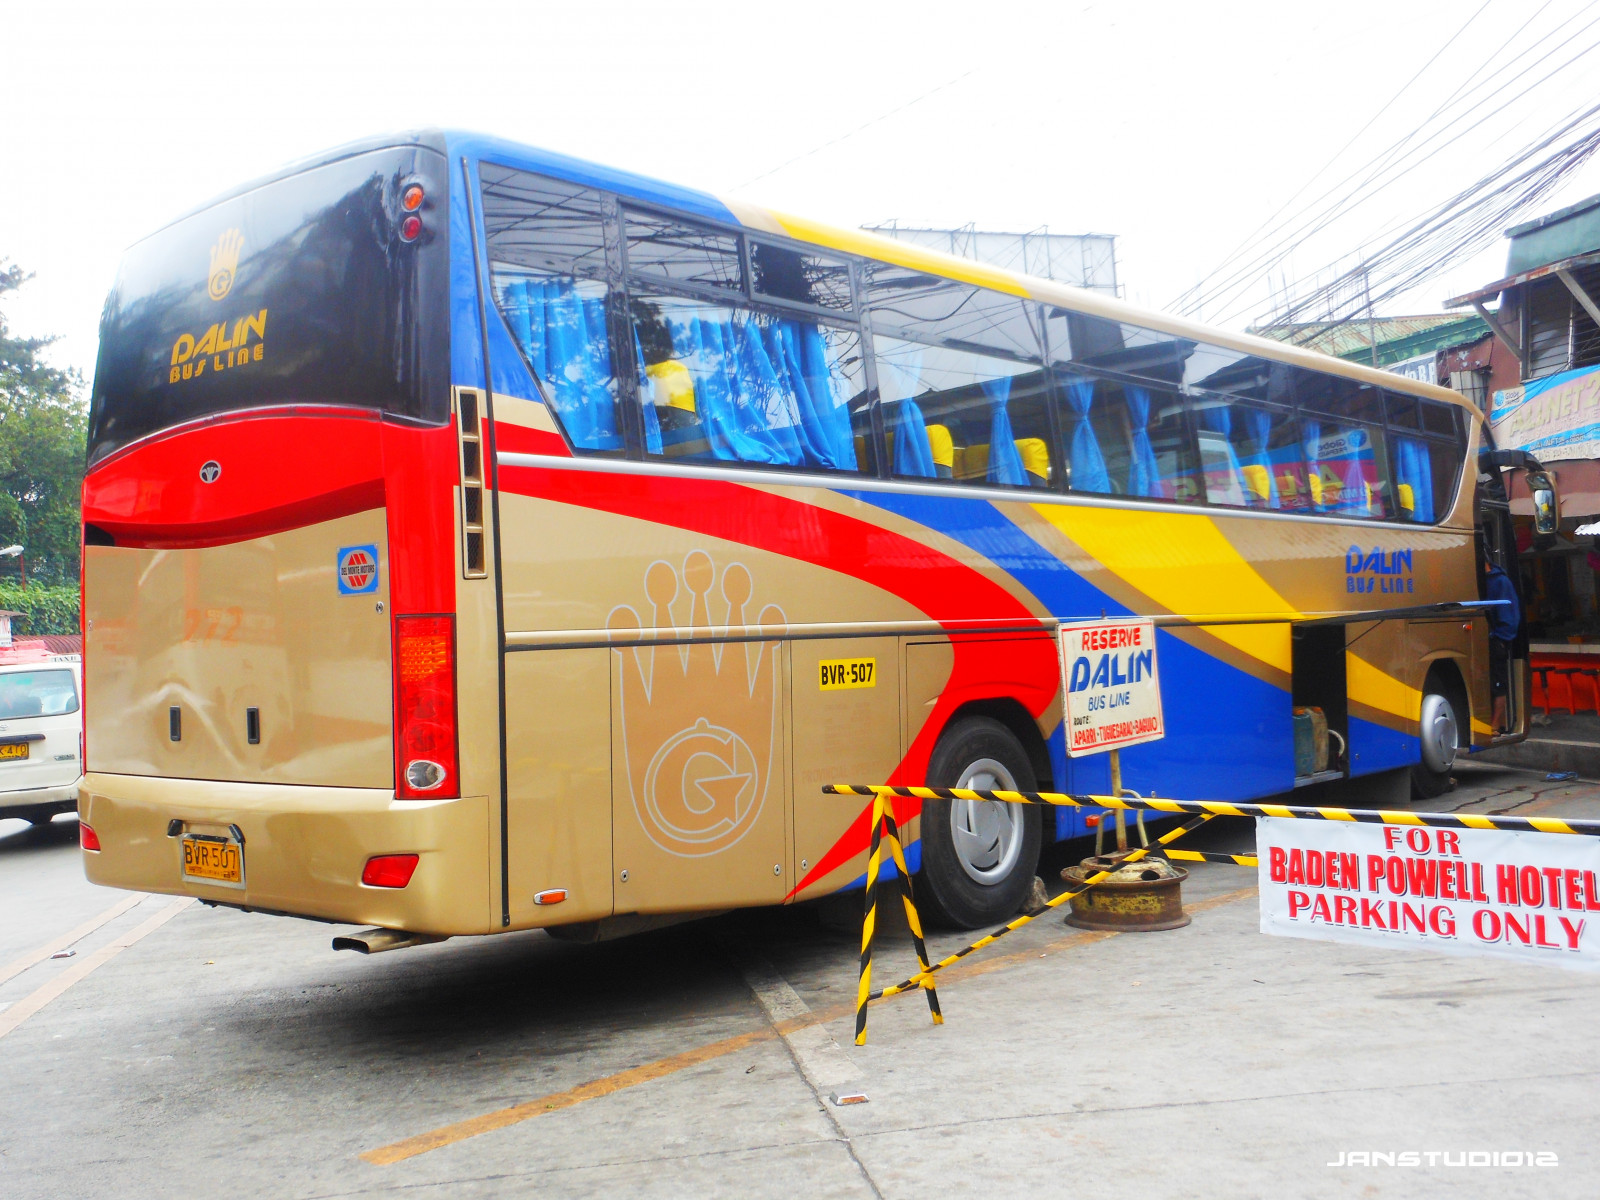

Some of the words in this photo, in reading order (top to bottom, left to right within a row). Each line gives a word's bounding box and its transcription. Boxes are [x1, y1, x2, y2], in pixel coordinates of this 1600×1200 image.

[171, 309, 268, 365] DALIN
[169, 359, 207, 384] BUS
[214, 343, 264, 371] LINE
[1345, 545, 1412, 574] DALIN
[1346, 576, 1375, 593] BUS
[1380, 577, 1414, 593] LINE
[1081, 627, 1141, 651] RESERVE
[1068, 649, 1153, 693] DALIN
[1088, 695, 1106, 711] BUS
[1109, 691, 1130, 708] LINE
[1383, 826, 1462, 857] FOR
[1269, 846, 1360, 892] BADEN
[1367, 854, 1489, 904] POWELL
[1496, 863, 1600, 913] HOTEL
[1288, 890, 1457, 939] PARKING
[1472, 909, 1586, 952] ONLY
